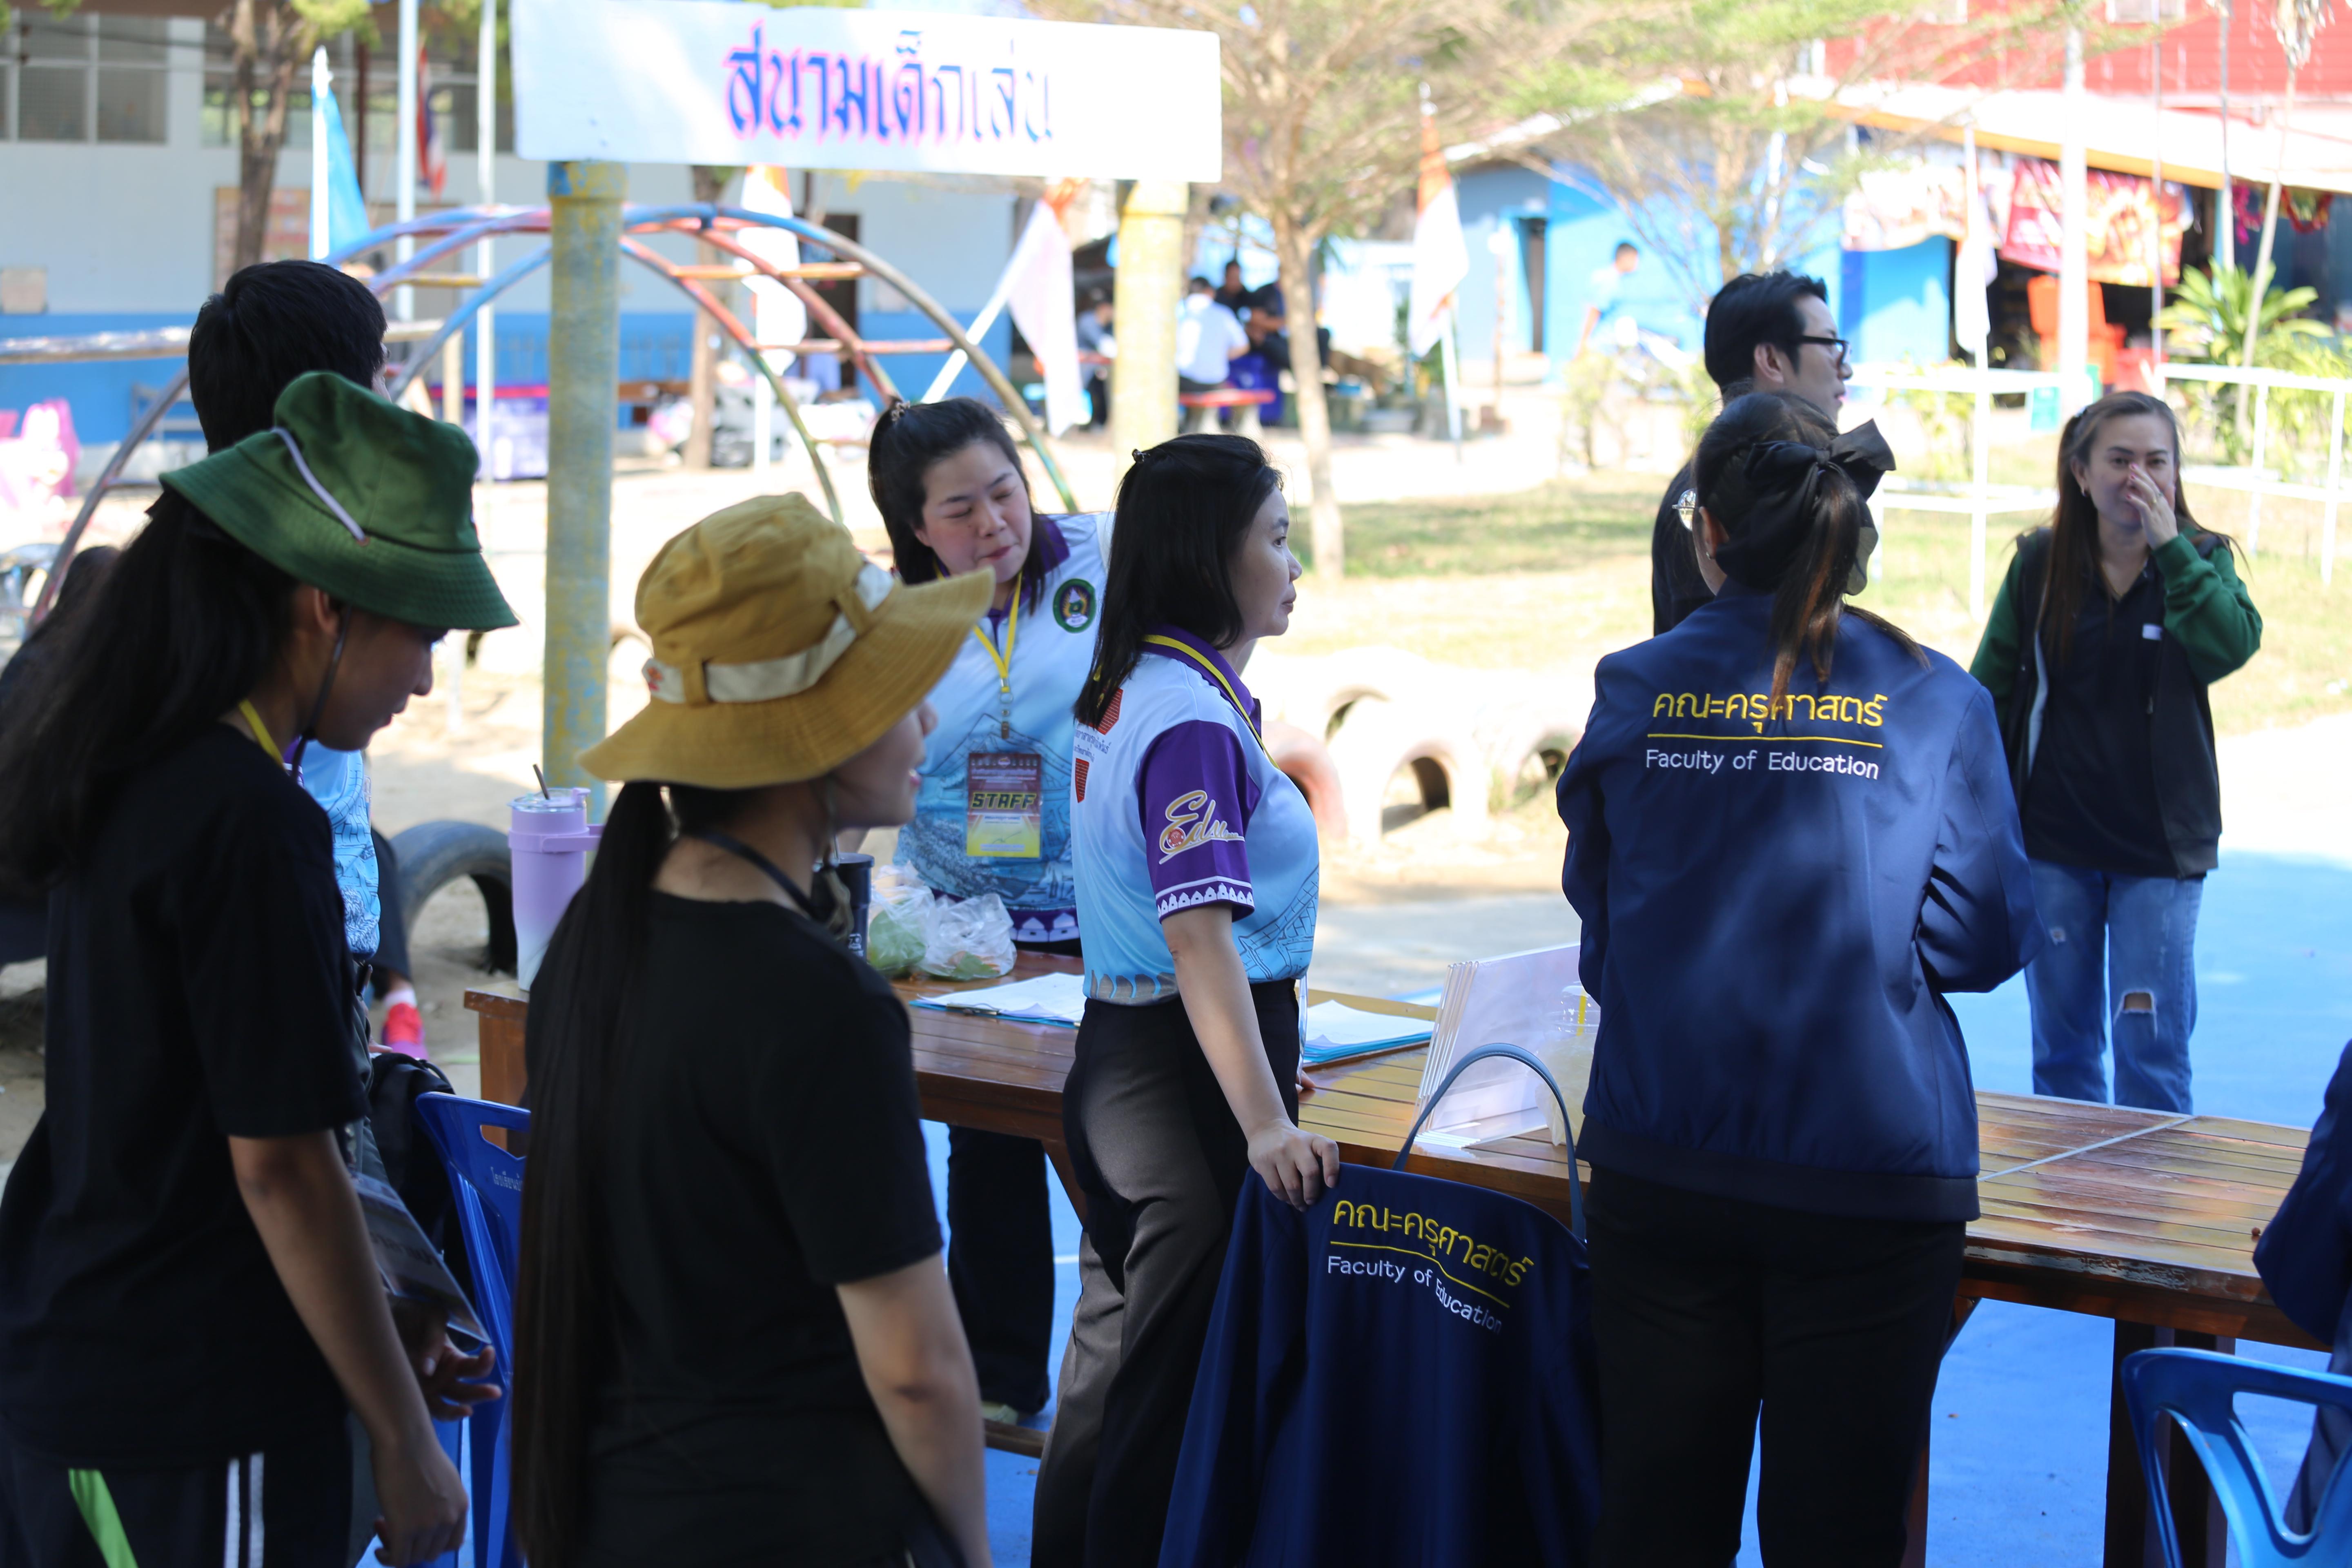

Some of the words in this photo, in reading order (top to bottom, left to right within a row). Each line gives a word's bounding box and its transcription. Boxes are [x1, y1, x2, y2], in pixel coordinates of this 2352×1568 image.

[723, 20, 1054, 147] สนามเด็กเล่น
[1653, 692, 1888, 734] คณะครุศาสตร์
[1646, 749, 1724, 774] Faculty
[1733, 750, 1757, 770] of
[1768, 752, 1879, 780] Education
[971, 791, 1037, 810] STAFF
[1334, 1200, 1535, 1287] คณะครุศาสตร์
[1328, 1256, 1405, 1283] Faculty
[1414, 1269, 1433, 1287] of
[1436, 1278, 1502, 1335] Education
